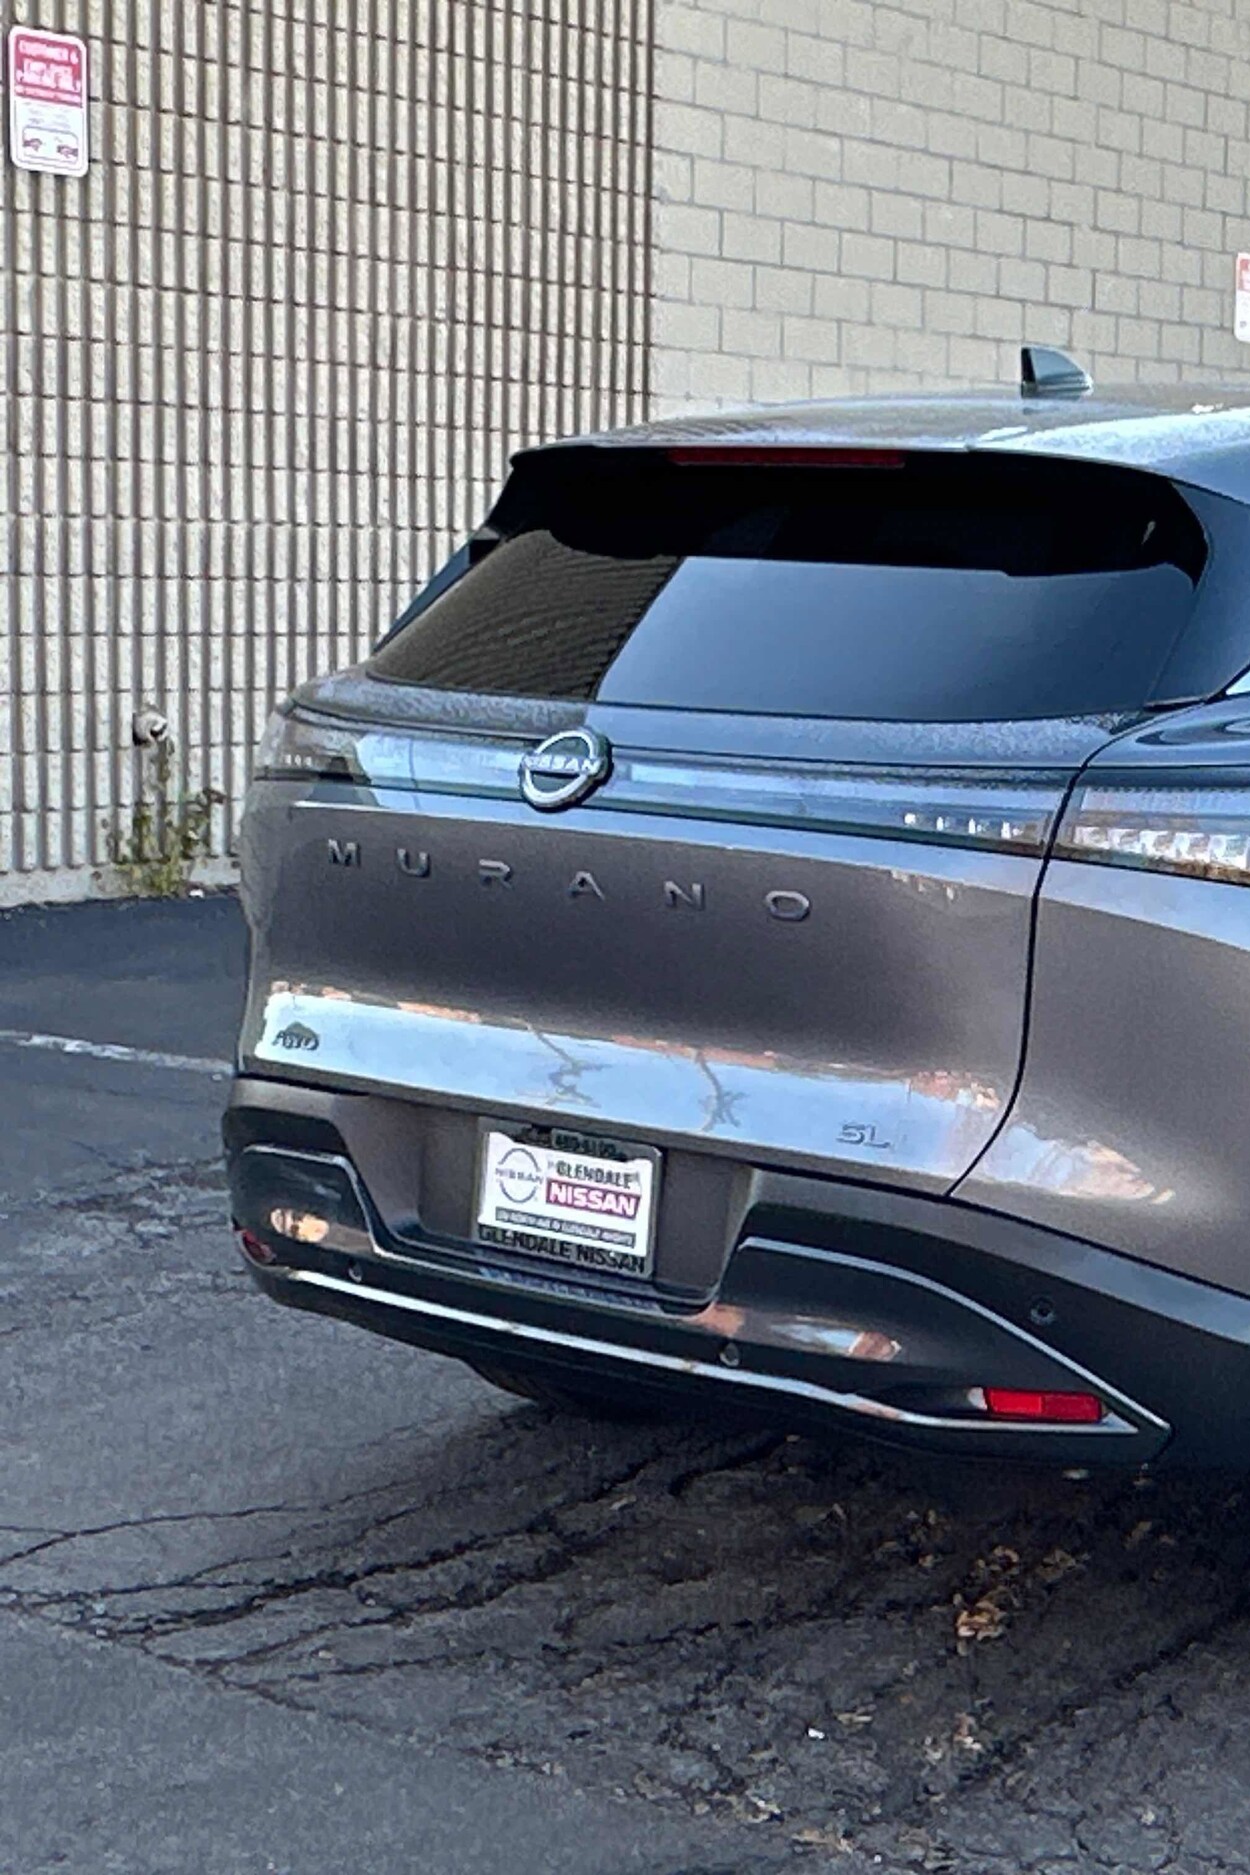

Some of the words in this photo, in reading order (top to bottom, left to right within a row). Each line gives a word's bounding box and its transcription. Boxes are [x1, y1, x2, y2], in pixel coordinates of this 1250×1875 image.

[327, 838, 811, 921] MURANO
[836, 1123, 891, 1148] SL
[556, 1161, 632, 1189] GLENDALE
[550, 1183, 636, 1216] NISSAN
[479, 1225, 570, 1258] GLENDALE
[576, 1244, 645, 1273] NISSAN
